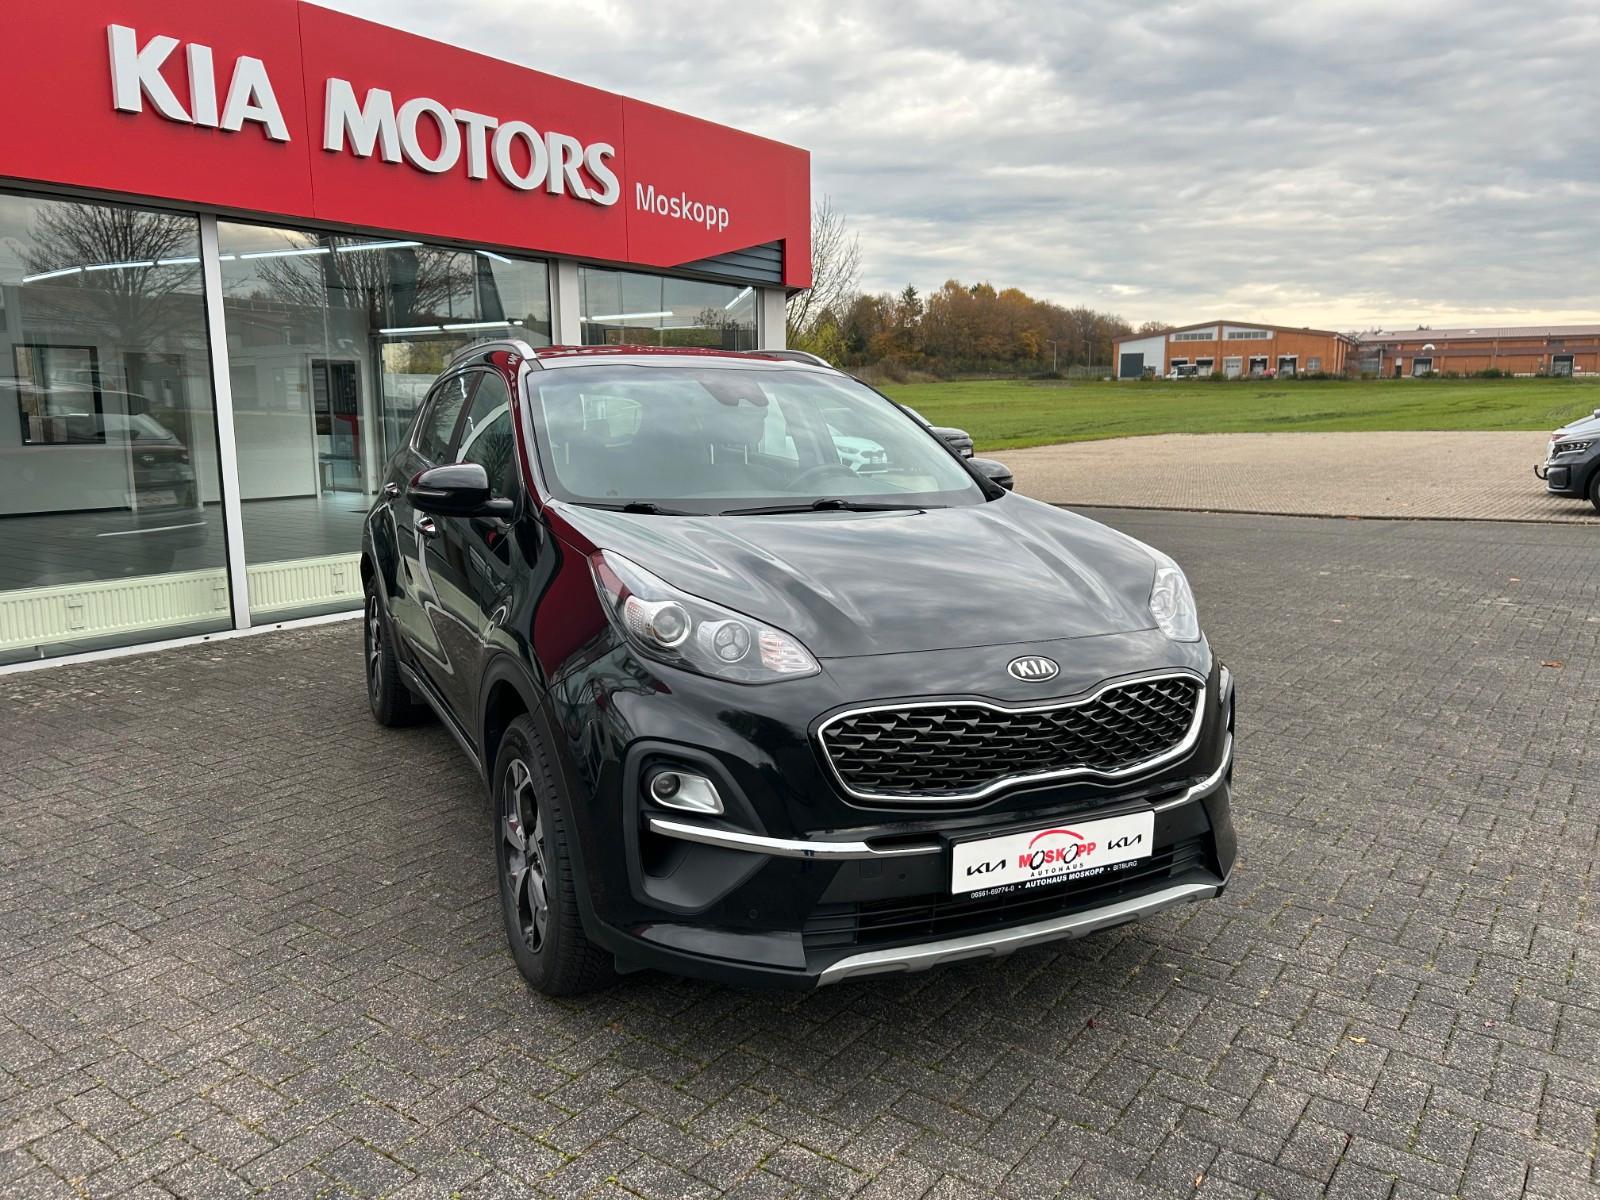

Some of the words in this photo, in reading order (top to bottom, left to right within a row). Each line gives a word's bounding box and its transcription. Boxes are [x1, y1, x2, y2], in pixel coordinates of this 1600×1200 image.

[107, 23, 291, 142] KIA
[323, 77, 620, 207] MOTORS
[635, 182, 730, 232] Moskopp
[1015, 659, 1054, 677] KIA
[1107, 833, 1142, 850] KIA
[966, 858, 1007, 877] KIA
[1018, 841, 1097, 871] MOSKOPP
[1025, 874, 1067, 889] AUTOHAUS
[1068, 867, 1105, 881] MOSKOPP
[1112, 860, 1138, 872] BITBURG
[1030, 862, 1085, 877] AUTOHAUS
